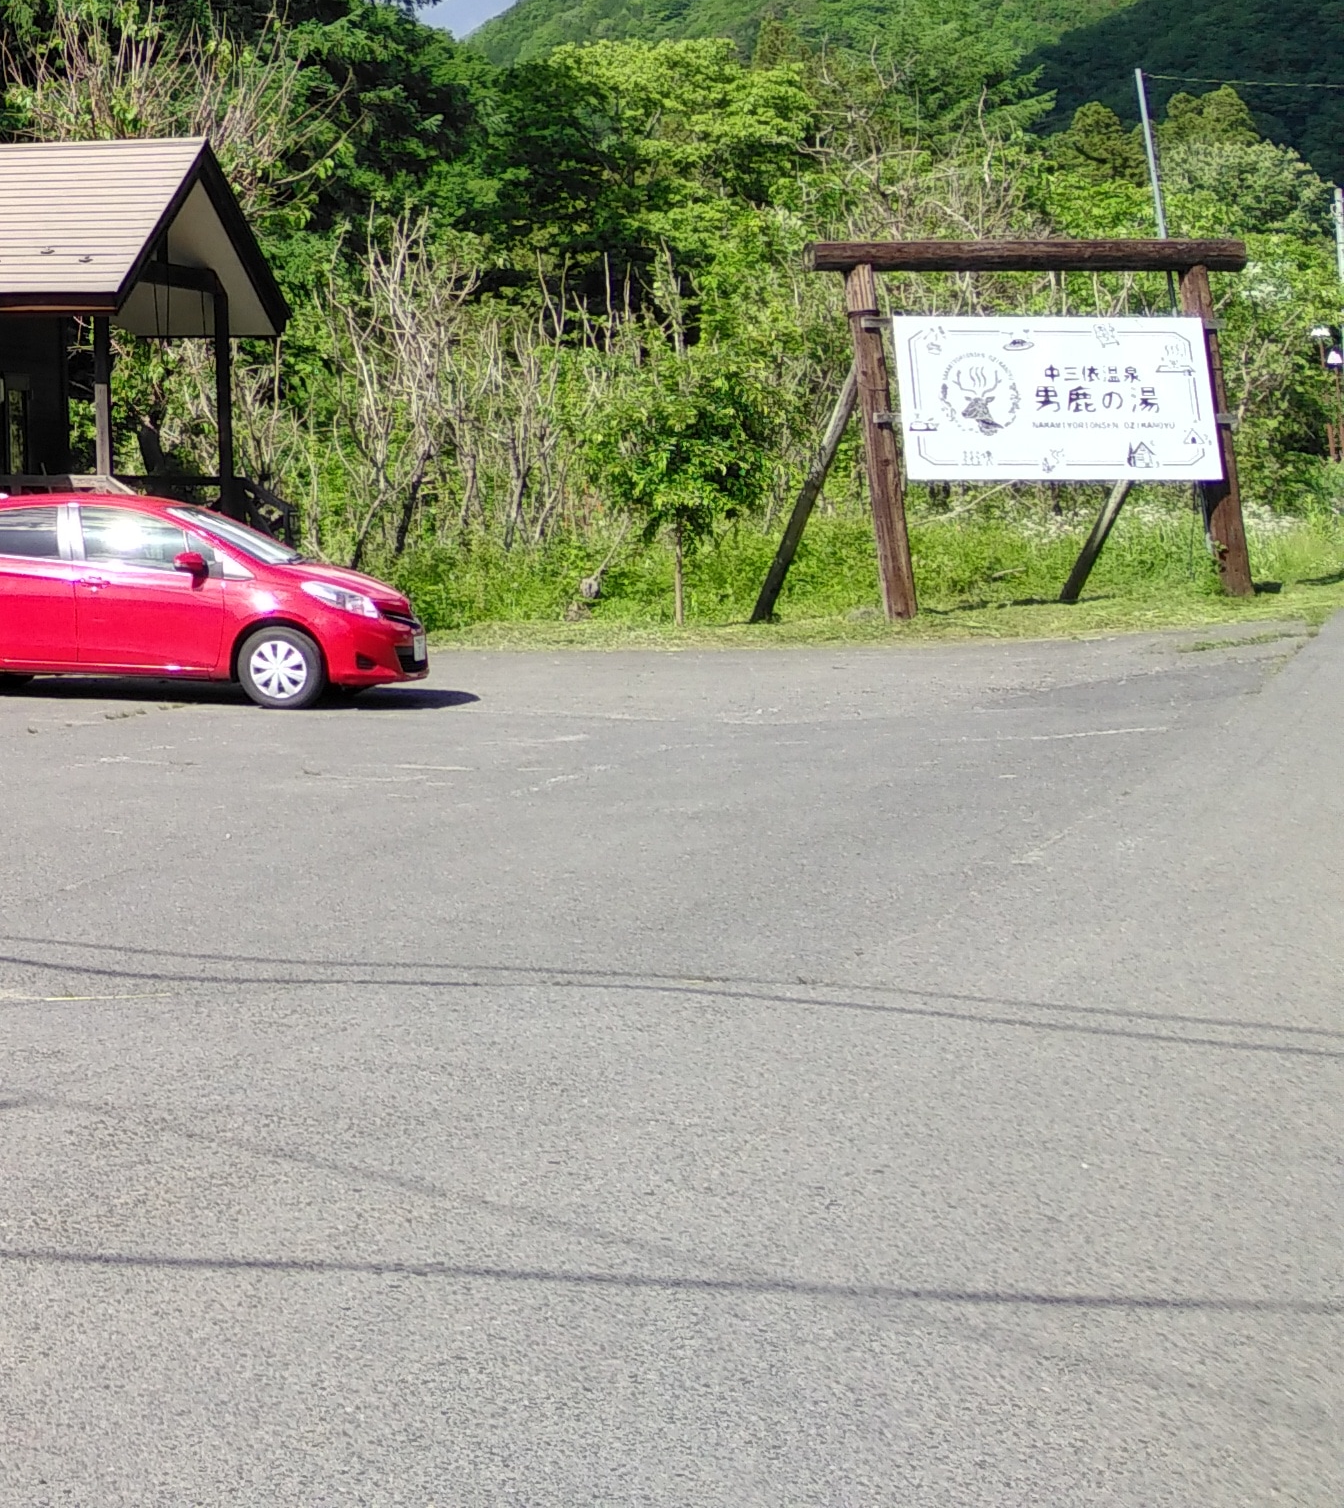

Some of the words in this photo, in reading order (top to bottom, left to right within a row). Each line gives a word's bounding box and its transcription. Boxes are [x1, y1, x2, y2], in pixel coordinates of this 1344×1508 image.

[1044, 364, 1141, 383] 中三依温泉
[1035, 386, 1160, 413] 男鹿の湯
